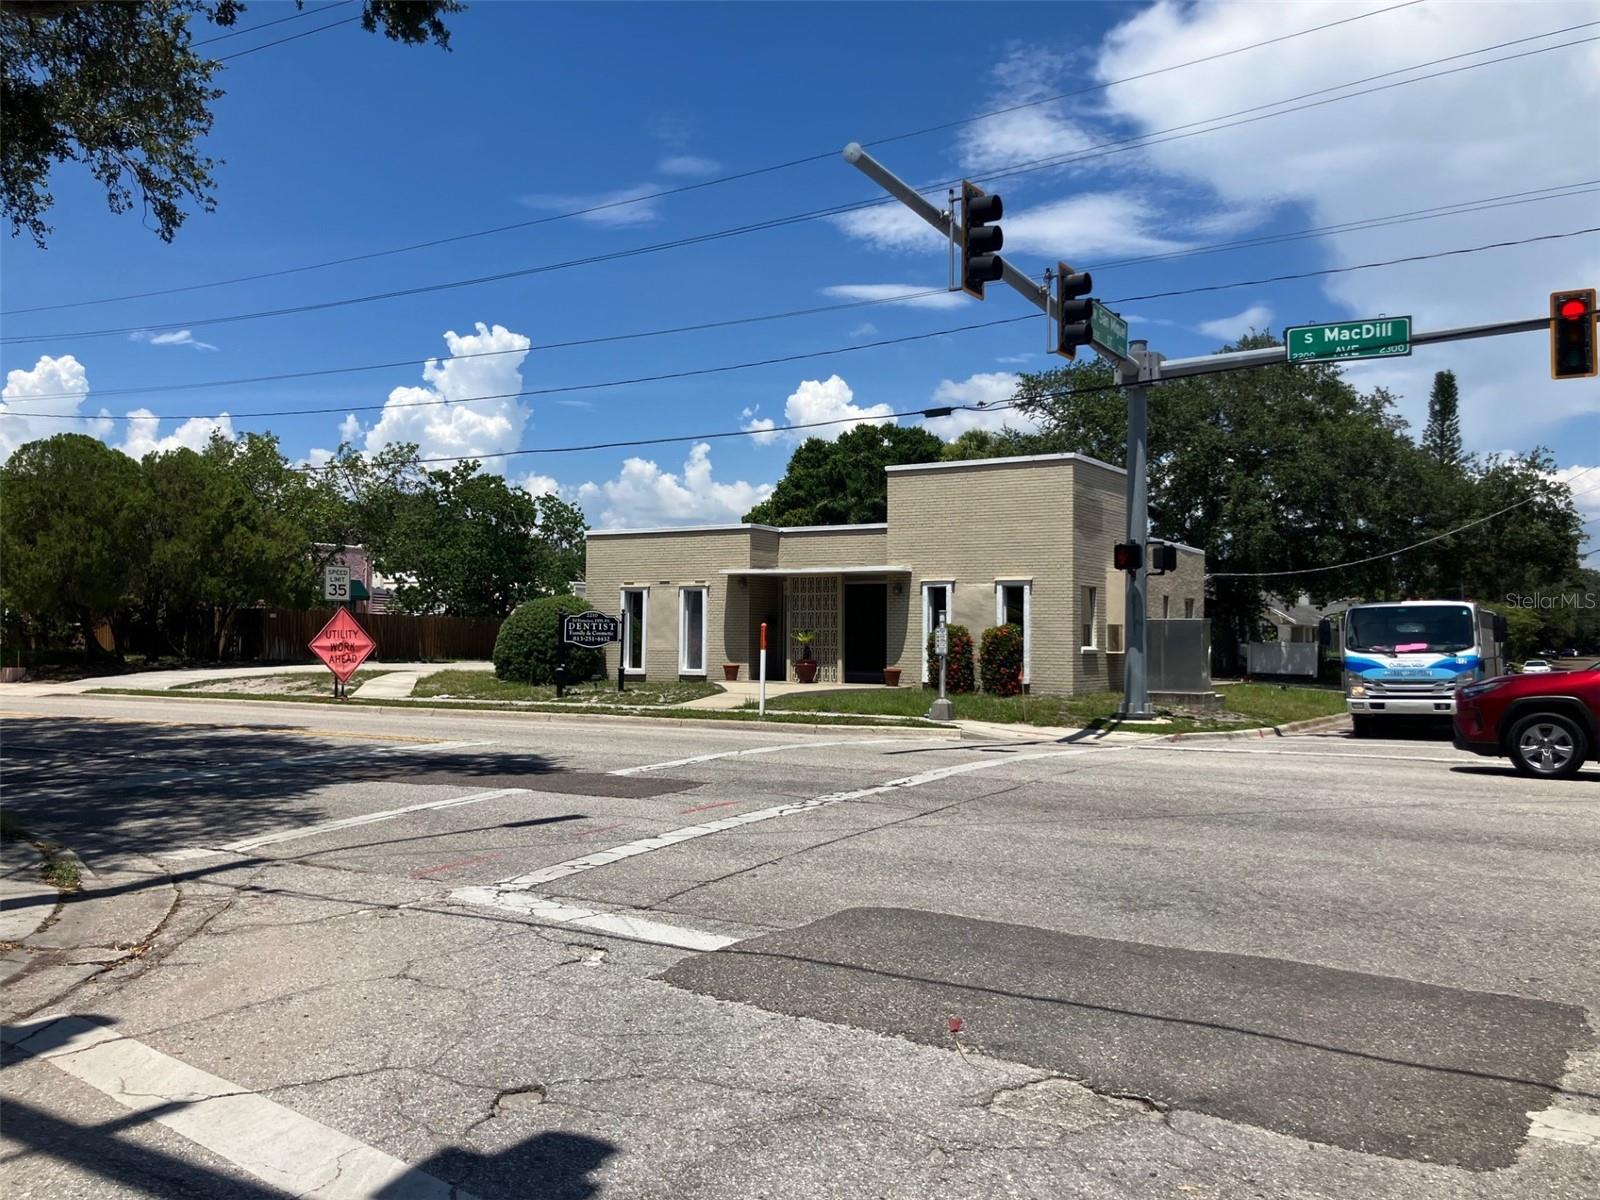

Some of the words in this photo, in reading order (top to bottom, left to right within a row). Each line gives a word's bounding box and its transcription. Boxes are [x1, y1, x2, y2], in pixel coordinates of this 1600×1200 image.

[1304, 333, 1313, 344] S
[1324, 322, 1392, 342] MacDill
[1334, 345, 1359, 357] AVE
[328, 584, 347, 597] 35
[568, 622, 616, 630] DENTIST
[325, 630, 359, 639] UTILITY
[330, 642, 355, 652] WORK
[329, 654, 357, 664] AHEAD
